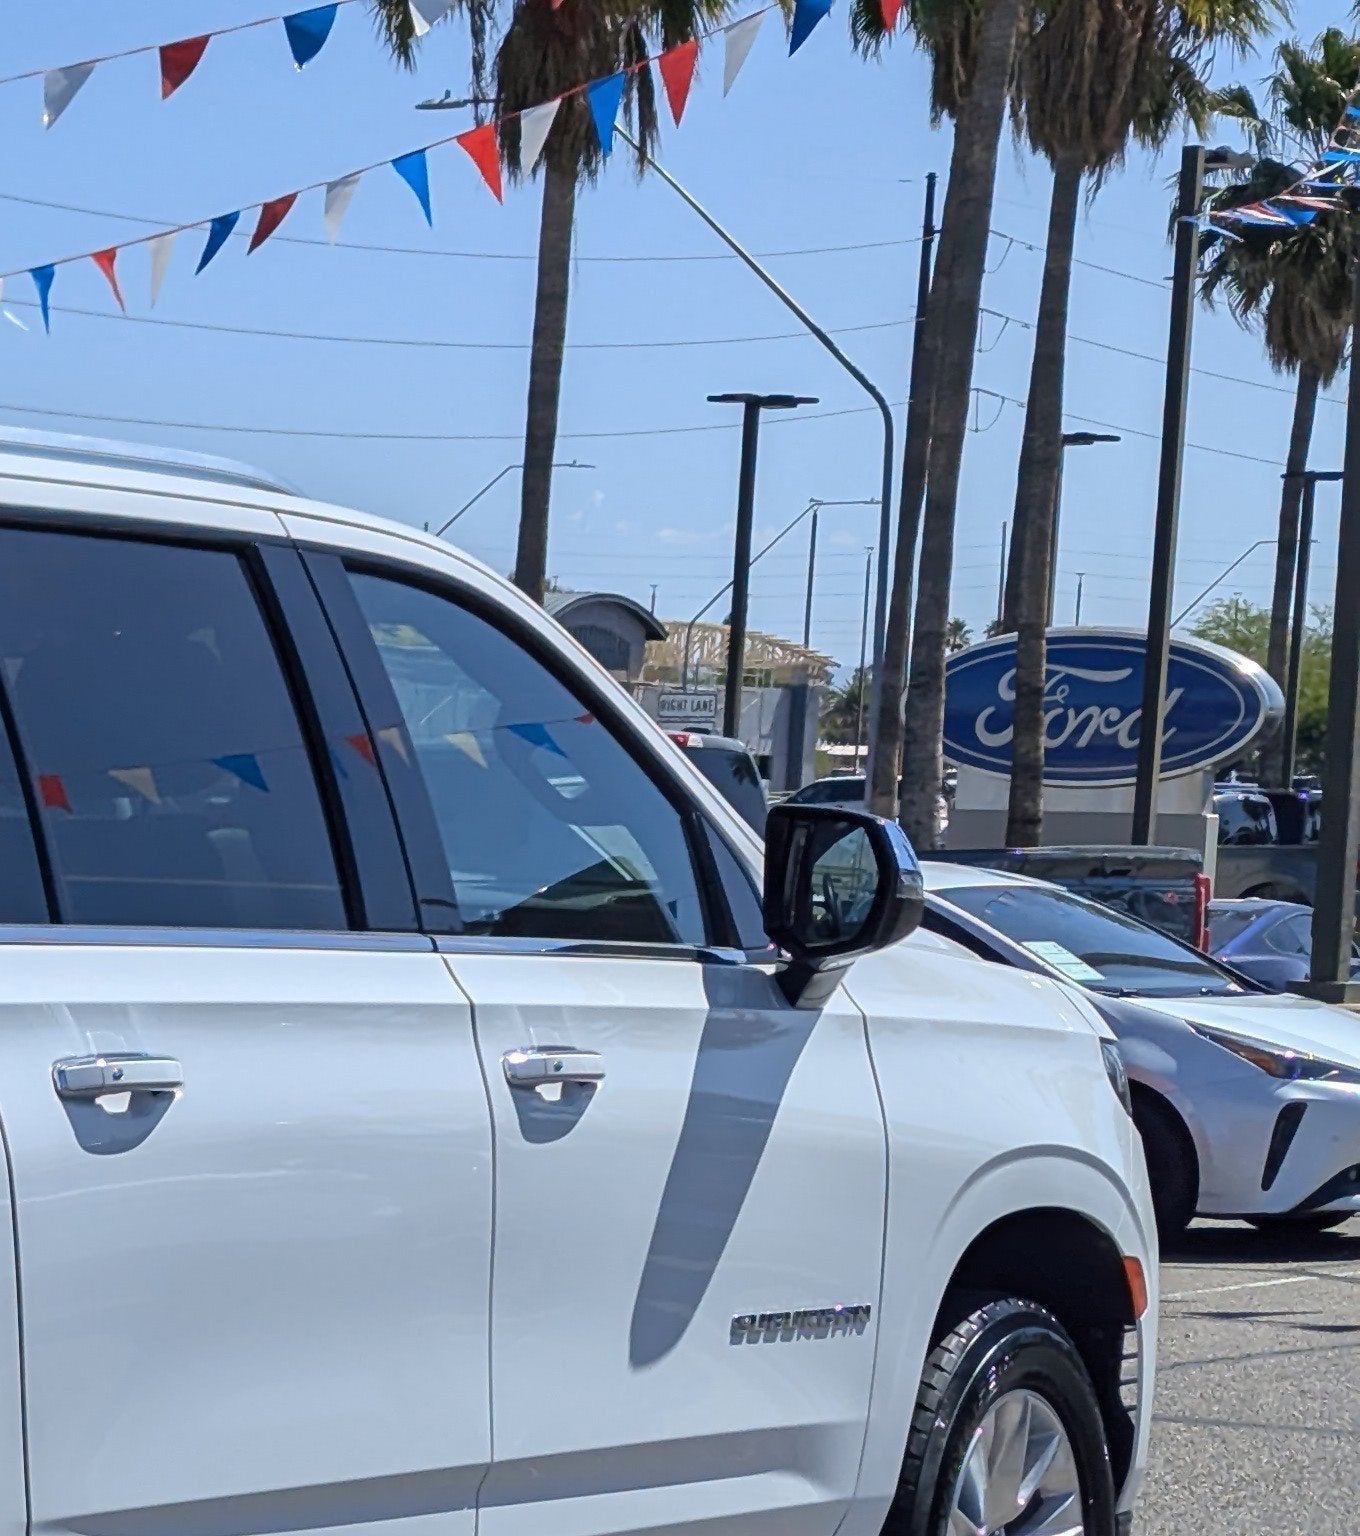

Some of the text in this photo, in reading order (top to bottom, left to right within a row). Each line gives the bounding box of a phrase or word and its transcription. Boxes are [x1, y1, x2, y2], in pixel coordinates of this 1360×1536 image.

[660, 698, 714, 712] RIGHT LANE
[730, 1304, 871, 1339] SUBURBAN
